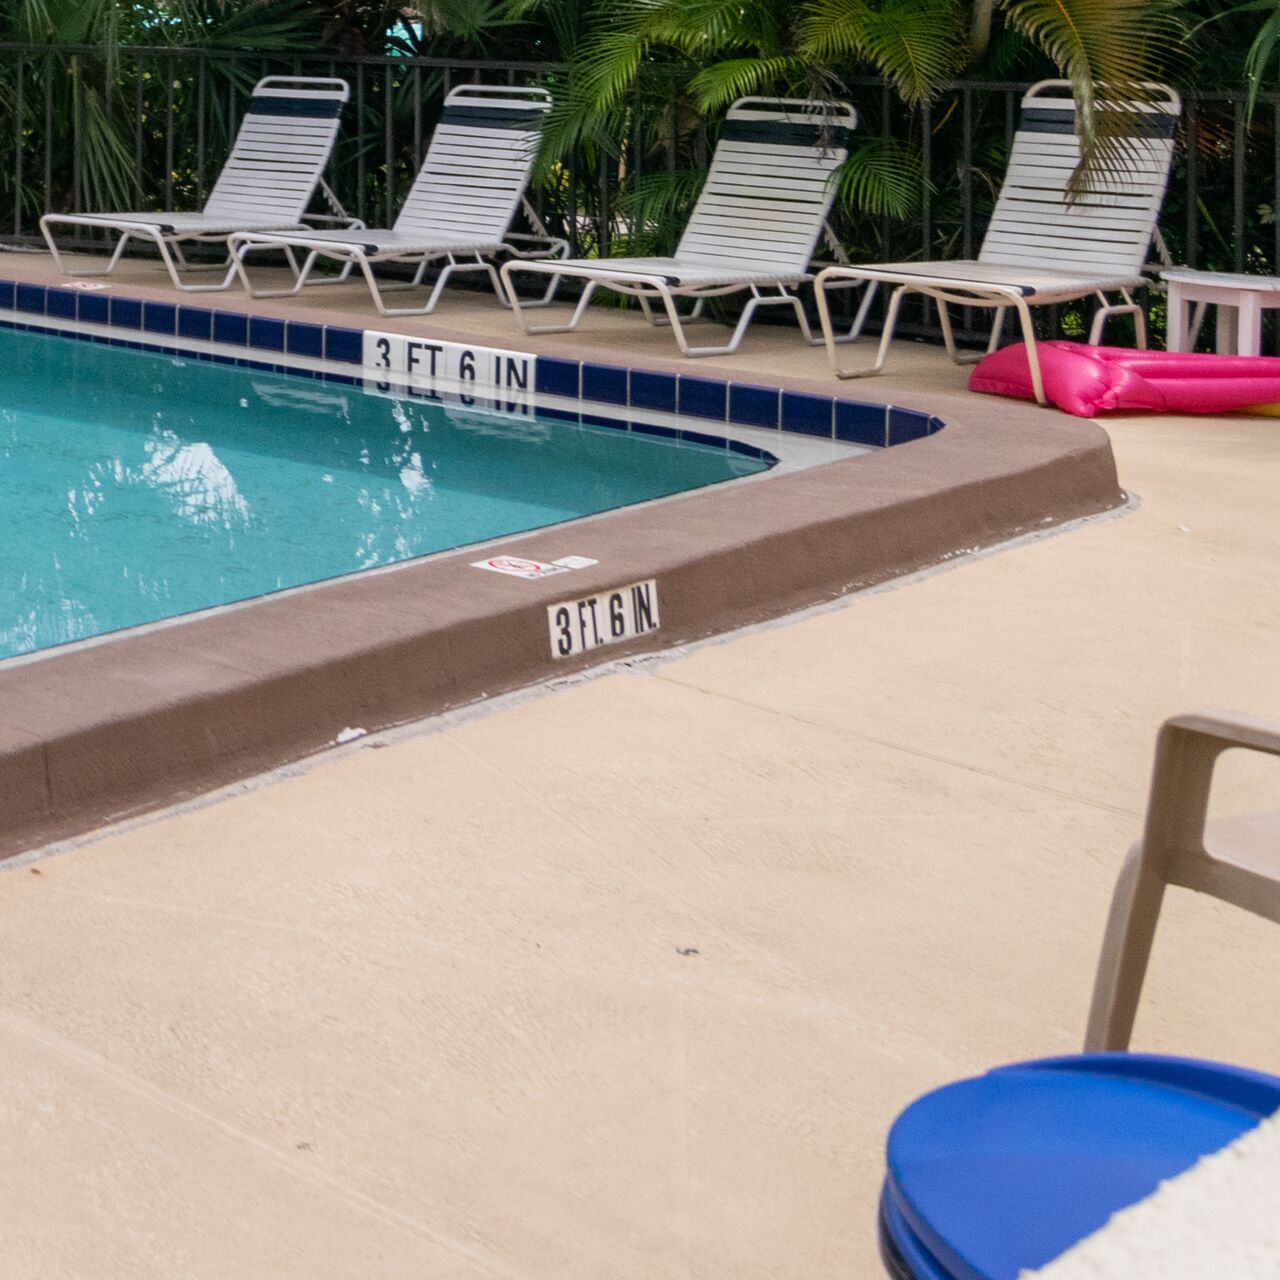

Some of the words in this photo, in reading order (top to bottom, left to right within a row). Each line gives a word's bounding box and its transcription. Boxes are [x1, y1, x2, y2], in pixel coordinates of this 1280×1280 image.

[375, 337, 391, 369] 3
[408, 341, 443, 376] FT
[459, 350, 476, 382] 6
[495, 355, 528, 389] IN
[556, 606, 573, 656] 3
[577, 597, 604, 650] FT.
[609, 592, 625, 638] 6
[631, 583, 658, 634] IN.
